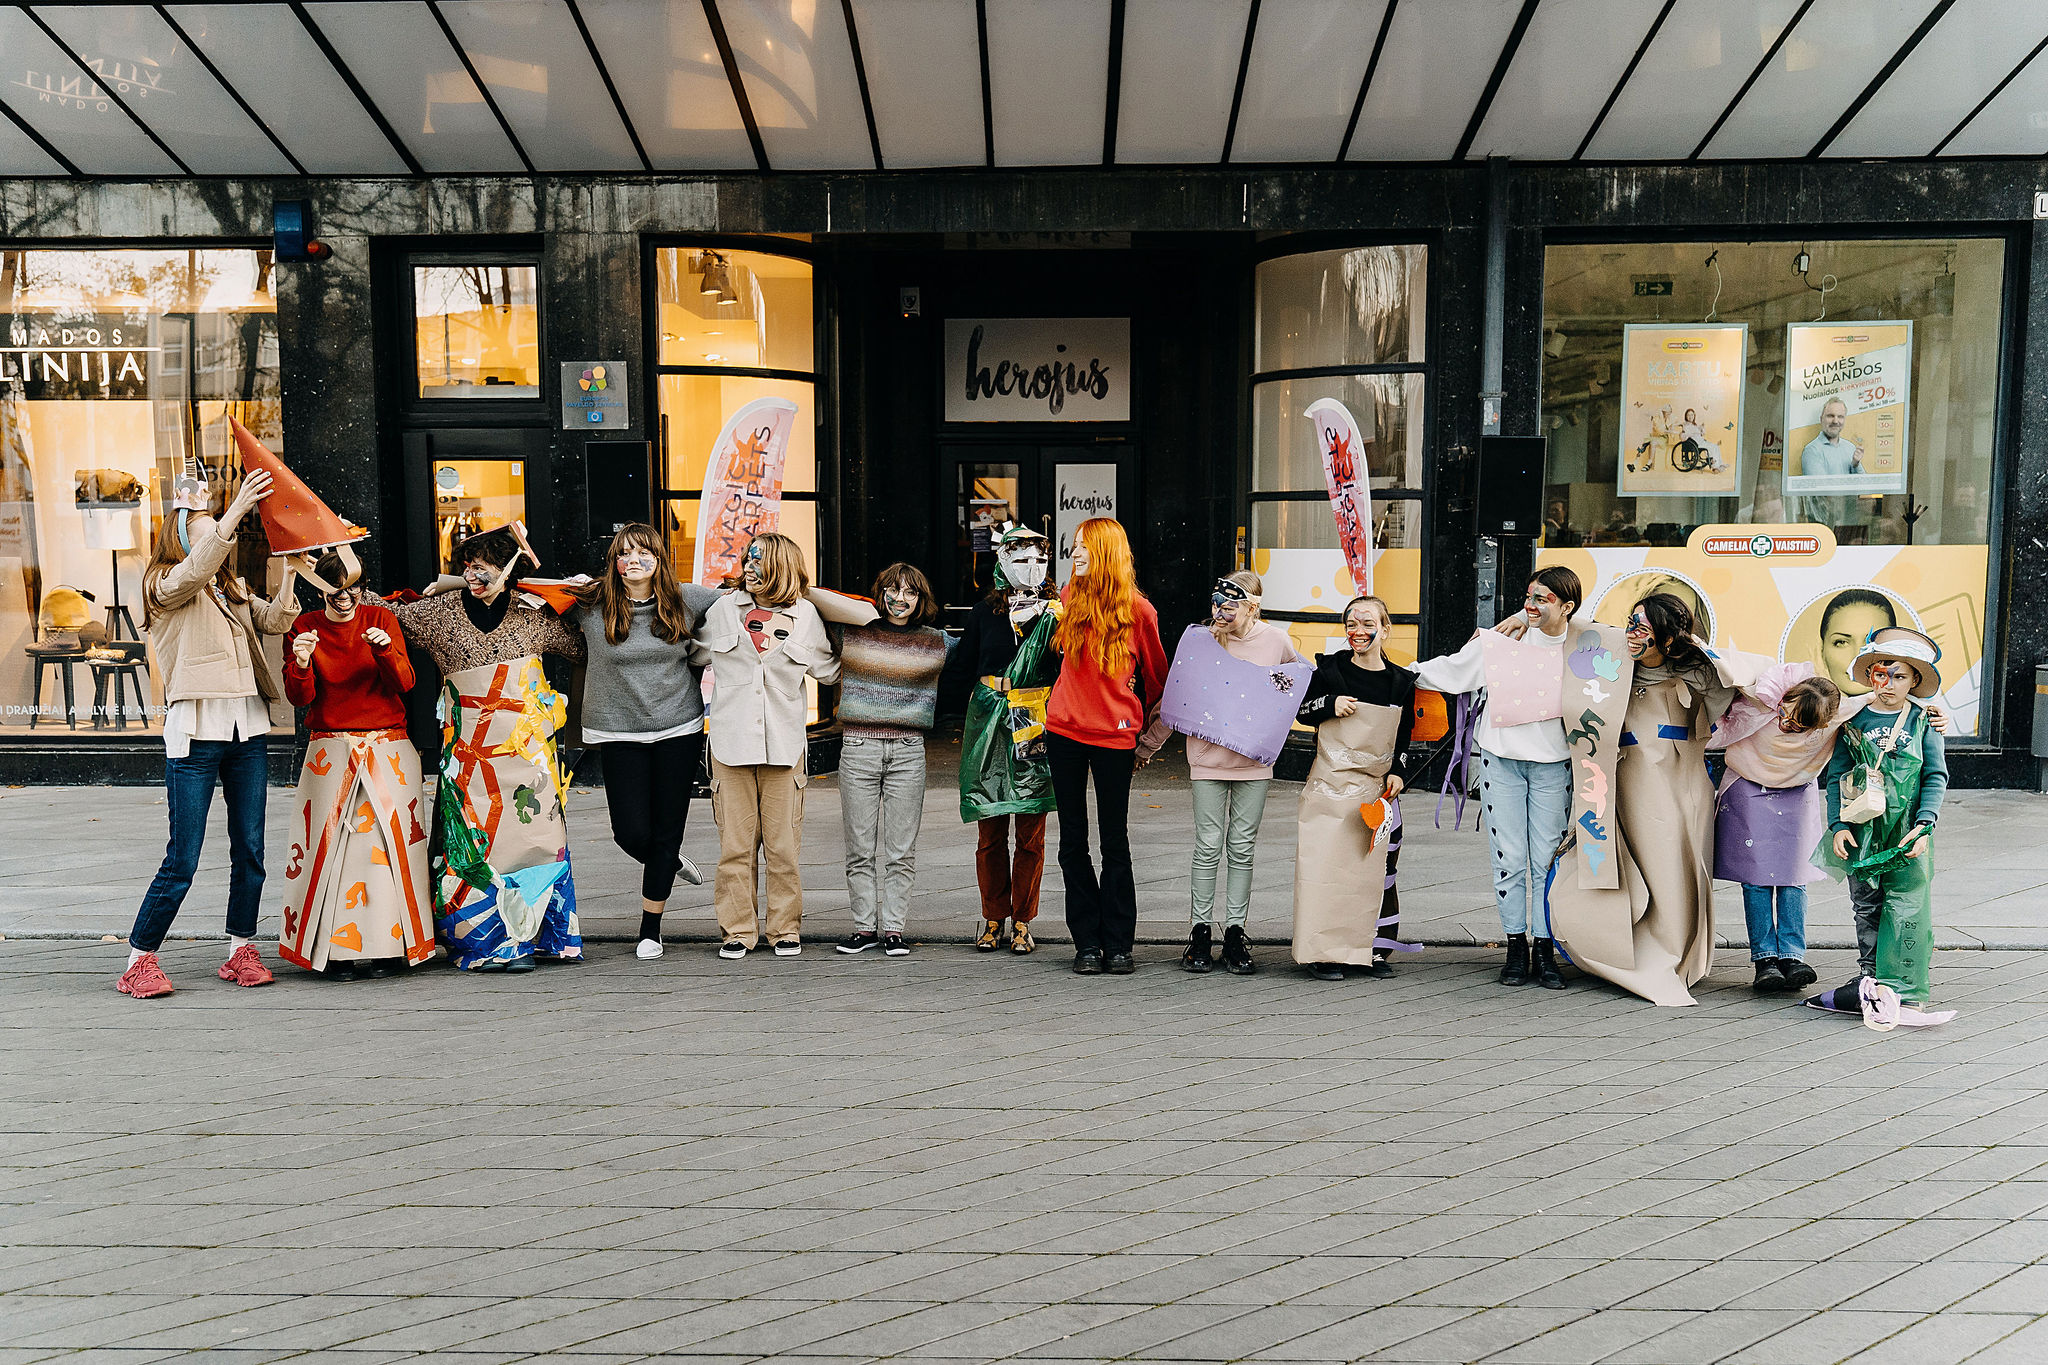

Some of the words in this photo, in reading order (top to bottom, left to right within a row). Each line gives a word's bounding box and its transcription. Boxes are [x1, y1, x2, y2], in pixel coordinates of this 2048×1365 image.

[12, 328, 123, 346] MADOS
[0, 352, 145, 387] LINIJA
[965, 324, 1110, 416] herojus
[1647, 360, 1721, 377] KARTU
[1803, 355, 1857, 379] LAIMĖS
[1803, 362, 1883, 390] VALANDOS
[1802, 386, 1839, 401] Nuolaidos
[741, 426, 771, 550] ARPETS
[1059, 482, 1113, 517] herojus
[719, 464, 746, 558] MAGIC
[1706, 541, 1748, 552] CAMELIA
[1774, 539, 1816, 552] VAISTINĖ
